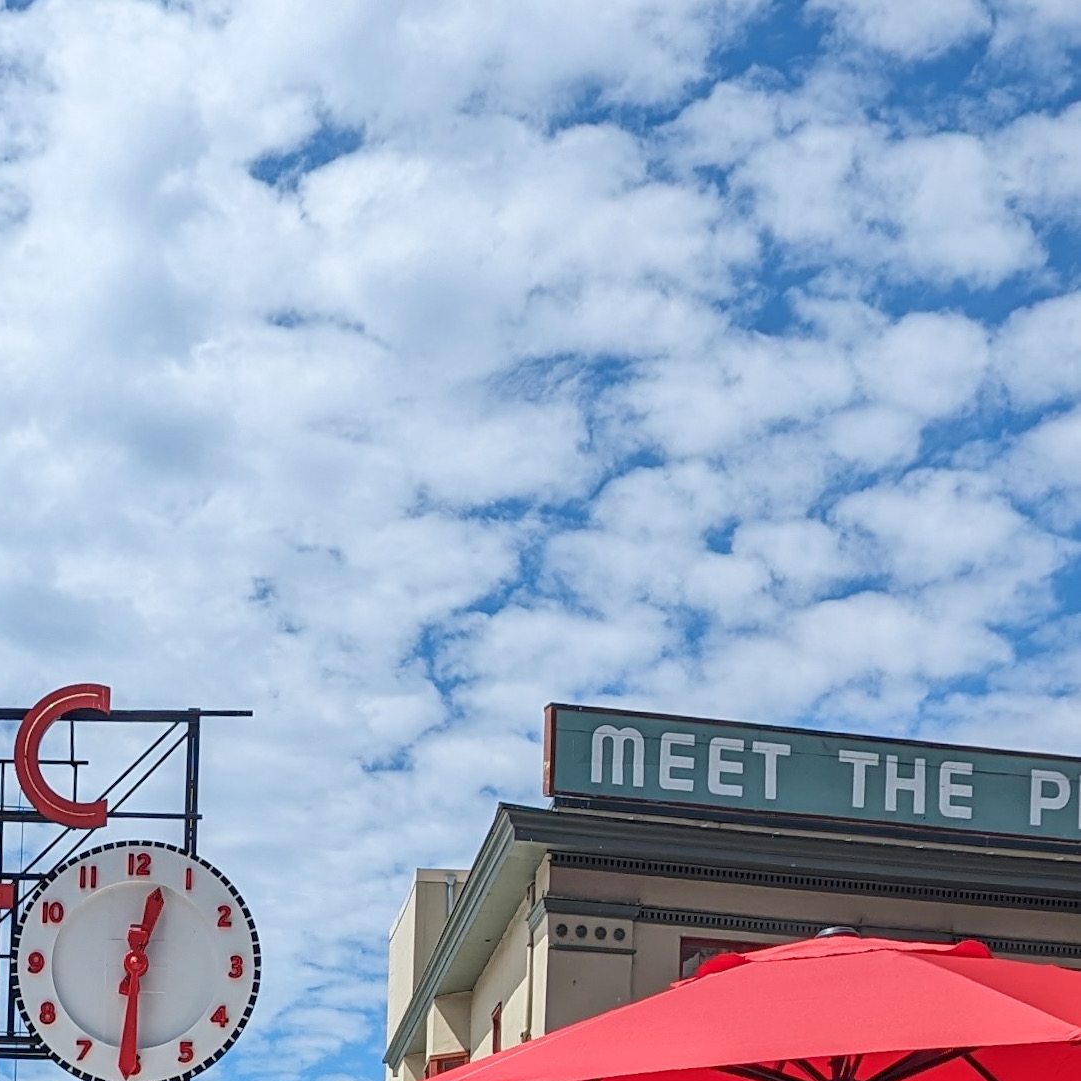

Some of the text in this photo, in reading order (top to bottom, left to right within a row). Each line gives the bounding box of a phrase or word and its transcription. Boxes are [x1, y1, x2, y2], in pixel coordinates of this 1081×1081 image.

[590, 725, 1081, 830] MEET THE P
[128, 853, 151, 876] 12
[79, 866, 98, 889] 11
[185, 868, 193, 890] 1
[42, 902, 64, 924] 10
[217, 905, 232, 928] 2
[28, 952, 45, 974] 9
[228, 955, 243, 979] 3
[39, 1001, 56, 1025] 8
[210, 1005, 229, 1028] 4
[76, 1040, 93, 1062] 7
[178, 1041, 194, 1063] 5
